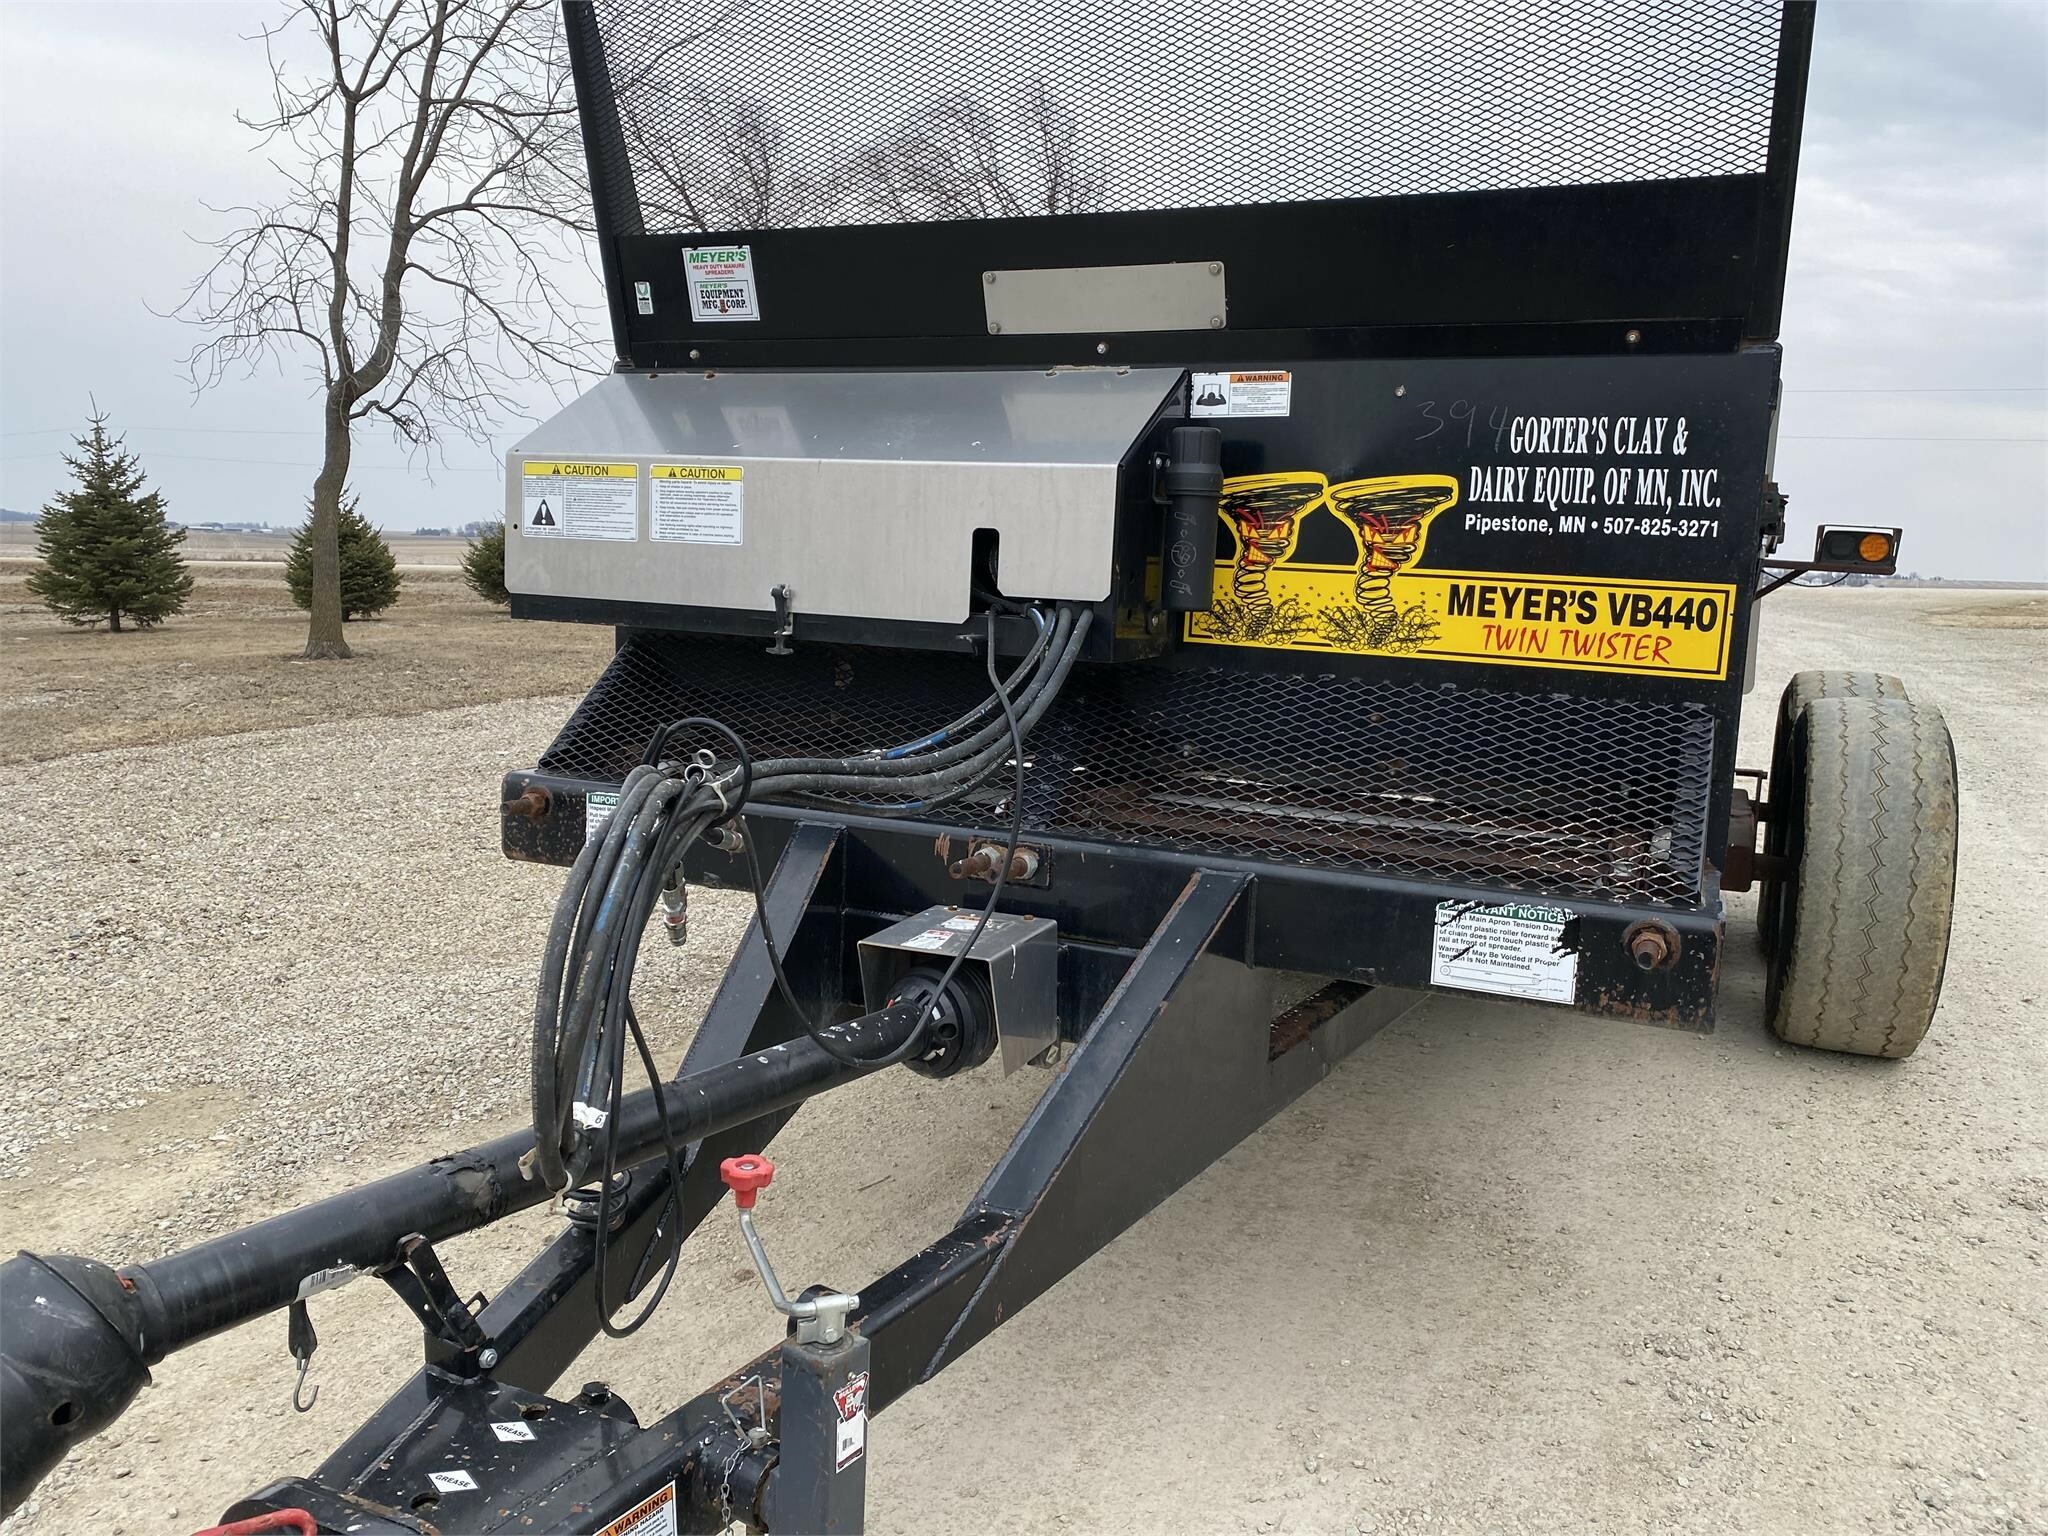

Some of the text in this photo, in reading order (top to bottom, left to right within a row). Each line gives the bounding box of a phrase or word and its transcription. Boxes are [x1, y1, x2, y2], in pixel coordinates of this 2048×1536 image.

[688, 250, 747, 263] MEYER'S
[700, 289, 744, 300] EQUIPMENT
[702, 299, 748, 310] MFG. CORP.
[1244, 374, 1284, 382] WARNING
[1510, 416, 1689, 455] GORTER'S CLAY &
[564, 464, 609, 476] CAUTION
[680, 468, 726, 478] CAUTION
[1468, 466, 1721, 514] DAIRY EQUIP. OF MN, INC.
[1465, 514, 1719, 538] Pipestone, MN 507-825-3271
[1448, 584, 1718, 632] MEYER'S VB440
[1483, 624, 1672, 664] TWIN TWISTER
[1468, 914, 1487, 923] Main
[1488, 918, 1510, 926] Apron
[1513, 920, 1542, 930] Tension
[1518, 908, 1565, 923] NOTICE
[1470, 932, 1488, 940] does
[1502, 936, 1524, 945] touch
[1524, 940, 1550, 948] plastic
[1474, 926, 1498, 936] plastic
[1500, 929, 1519, 937] roller
[1520, 931, 1549, 941] forward
[1460, 938, 1478, 946] front
[1488, 943, 1522, 953] spreader.
[1472, 949, 1488, 958] May
[1500, 953, 1526, 962] Voided
[1534, 958, 1560, 967] Proper
[1490, 959, 1532, 971] Maintained.
[496, 1424, 528, 1438] GREASE
[435, 1474, 471, 1488] GREASE
[614, 1492, 668, 1535] WARNING
[640, 1507, 664, 1526] HAZARD
